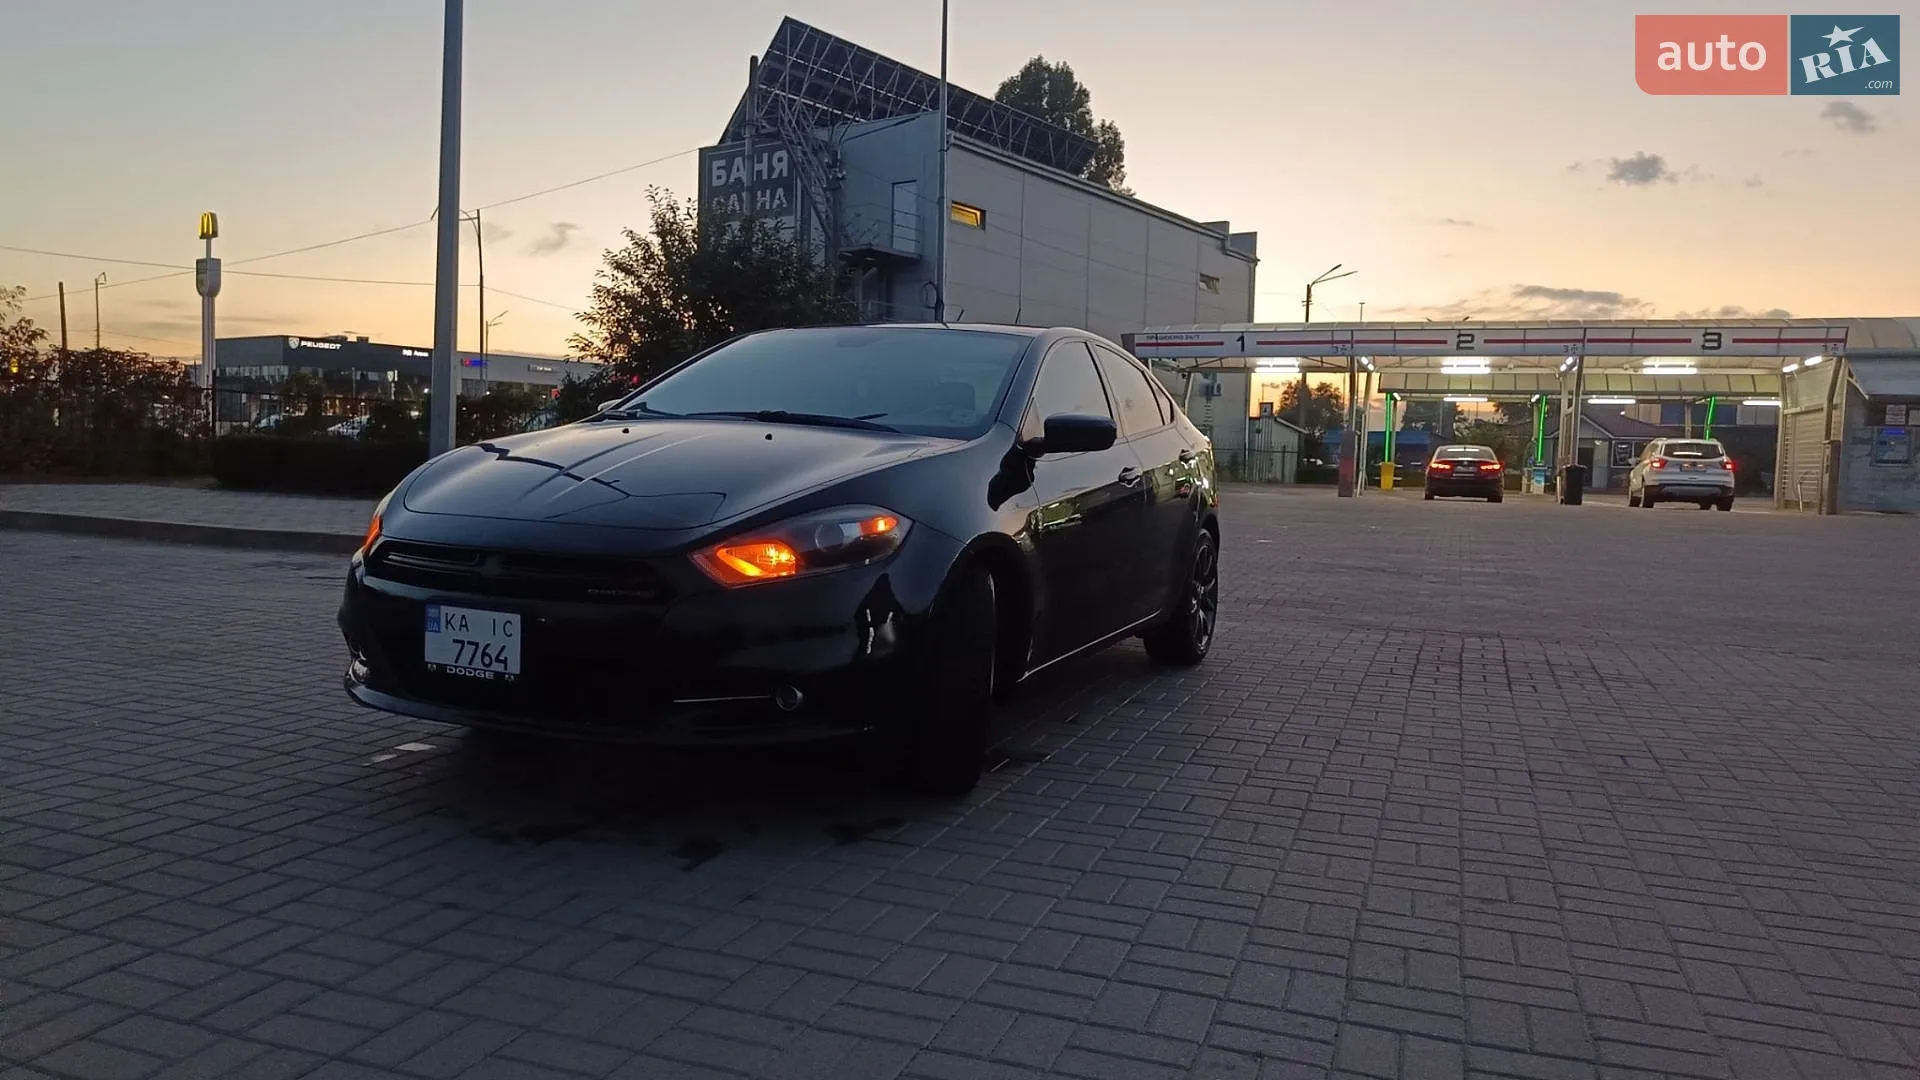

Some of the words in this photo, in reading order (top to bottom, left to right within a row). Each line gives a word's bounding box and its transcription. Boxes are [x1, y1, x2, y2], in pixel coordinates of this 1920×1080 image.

[712, 150, 788, 187] БАНЯ
[300, 340, 343, 350] PEUGEOT
[1236, 334, 1245, 352] 1
[1456, 333, 1475, 351] 2
[1701, 332, 1722, 351] 3
[445, 612, 470, 632] KA
[491, 617, 513, 638] IC
[452, 638, 508, 670] 7764
[446, 666, 494, 680] DODGE
